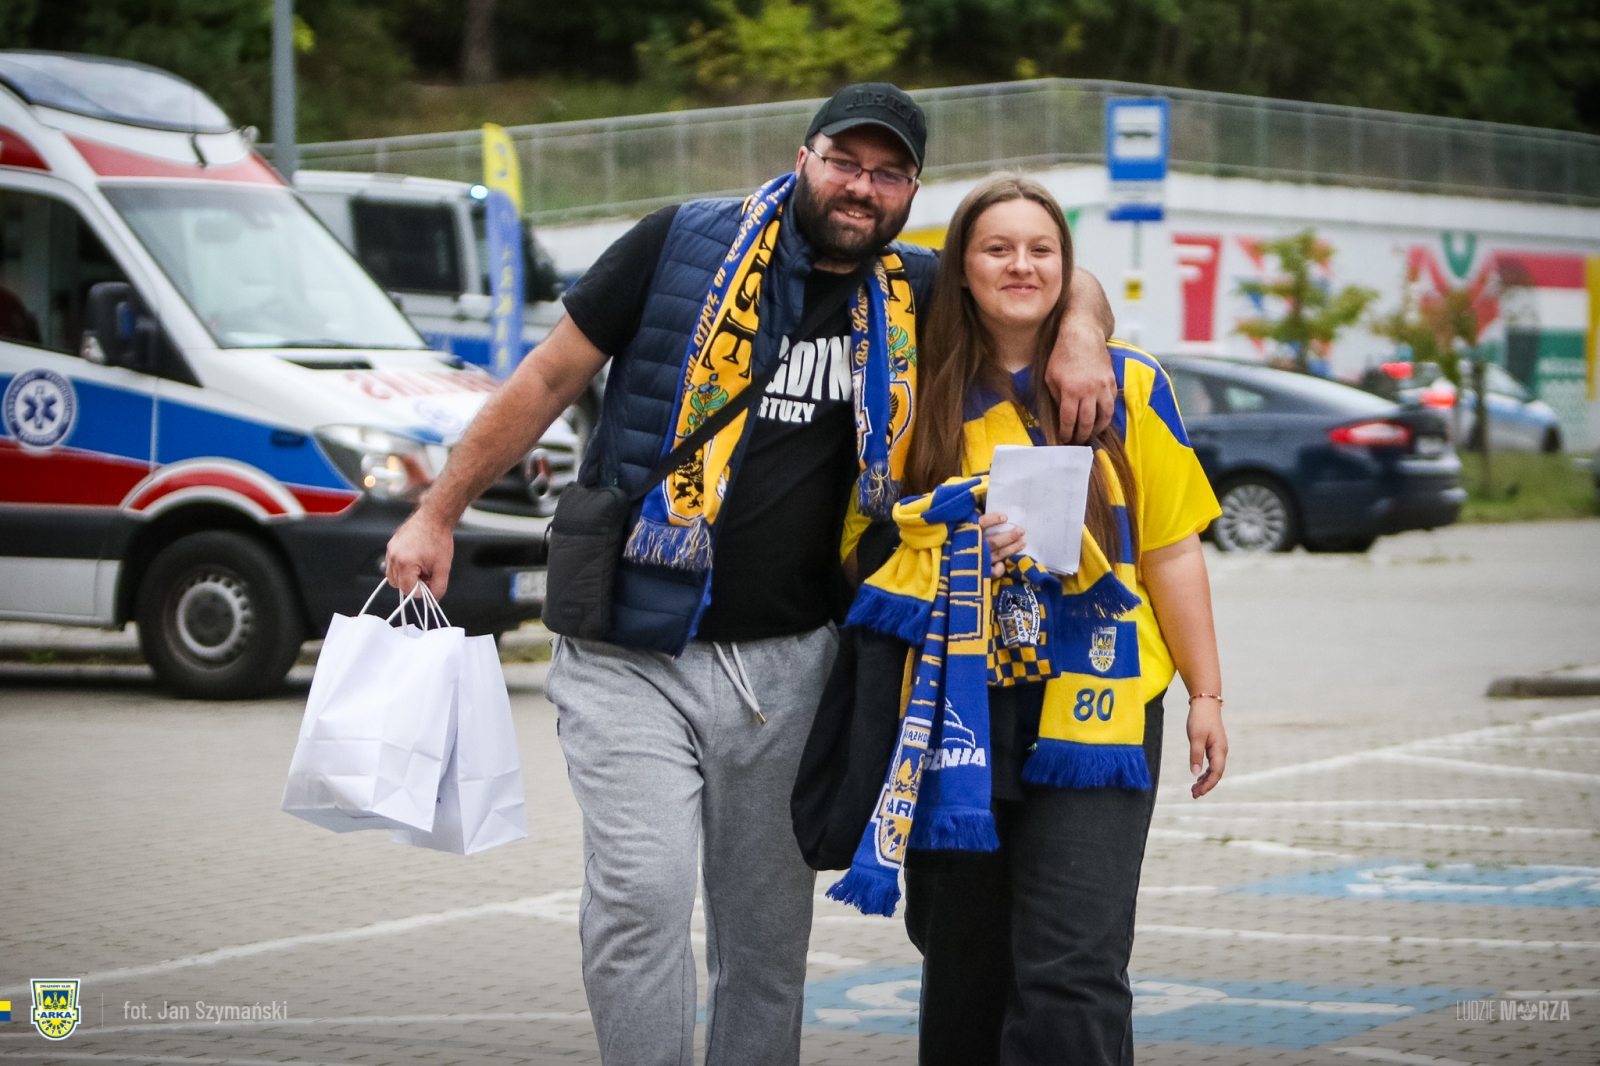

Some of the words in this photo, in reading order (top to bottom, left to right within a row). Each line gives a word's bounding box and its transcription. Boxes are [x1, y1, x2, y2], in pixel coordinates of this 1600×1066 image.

[757, 396, 815, 423] RTUZY
[1073, 688, 1115, 722] 80
[886, 797, 915, 818] AR
